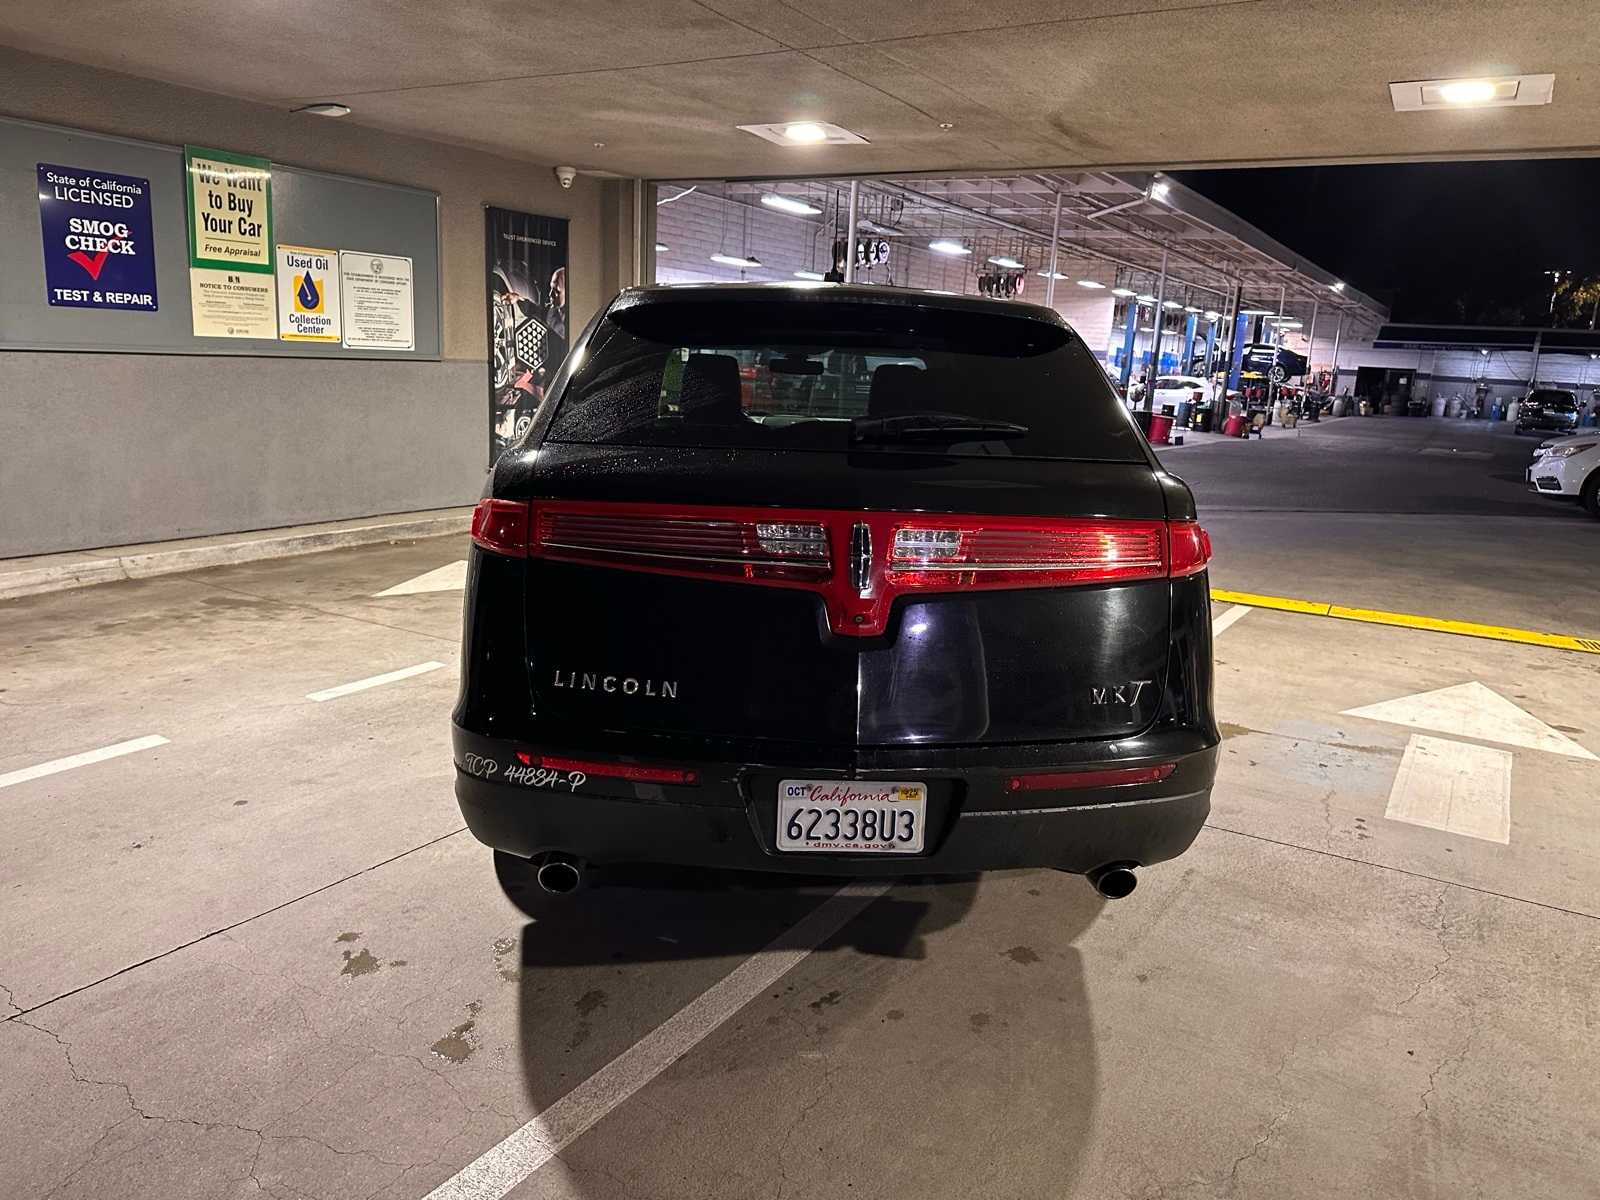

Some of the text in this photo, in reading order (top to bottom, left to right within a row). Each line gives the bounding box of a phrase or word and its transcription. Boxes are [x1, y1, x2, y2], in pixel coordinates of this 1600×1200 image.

[46, 171, 142, 194] State of California
[224, 168, 262, 192] Want
[55, 186, 134, 208] LICENSED
[208, 190, 253, 217] to Buy
[69, 218, 129, 238] SMOG
[201, 212, 262, 237] Your Car
[65, 235, 136, 255] CHECK
[205, 244, 261, 257] Free Appraisal
[287, 255, 329, 270] Used Oil
[54, 289, 153, 306] TEST & REPAIR
[200, 282, 222, 290] NOTICE
[233, 285, 268, 293] CONSUMERS
[289, 313, 331, 326] Collection
[297, 323, 324, 334] Center
[554, 669, 678, 699] LINCOLN
[1090, 680, 1152, 707] MKT
[464, 752, 498, 780] TCP
[787, 786, 806, 797] OCT
[809, 785, 902, 808] California
[787, 807, 915, 843] 62338U3
